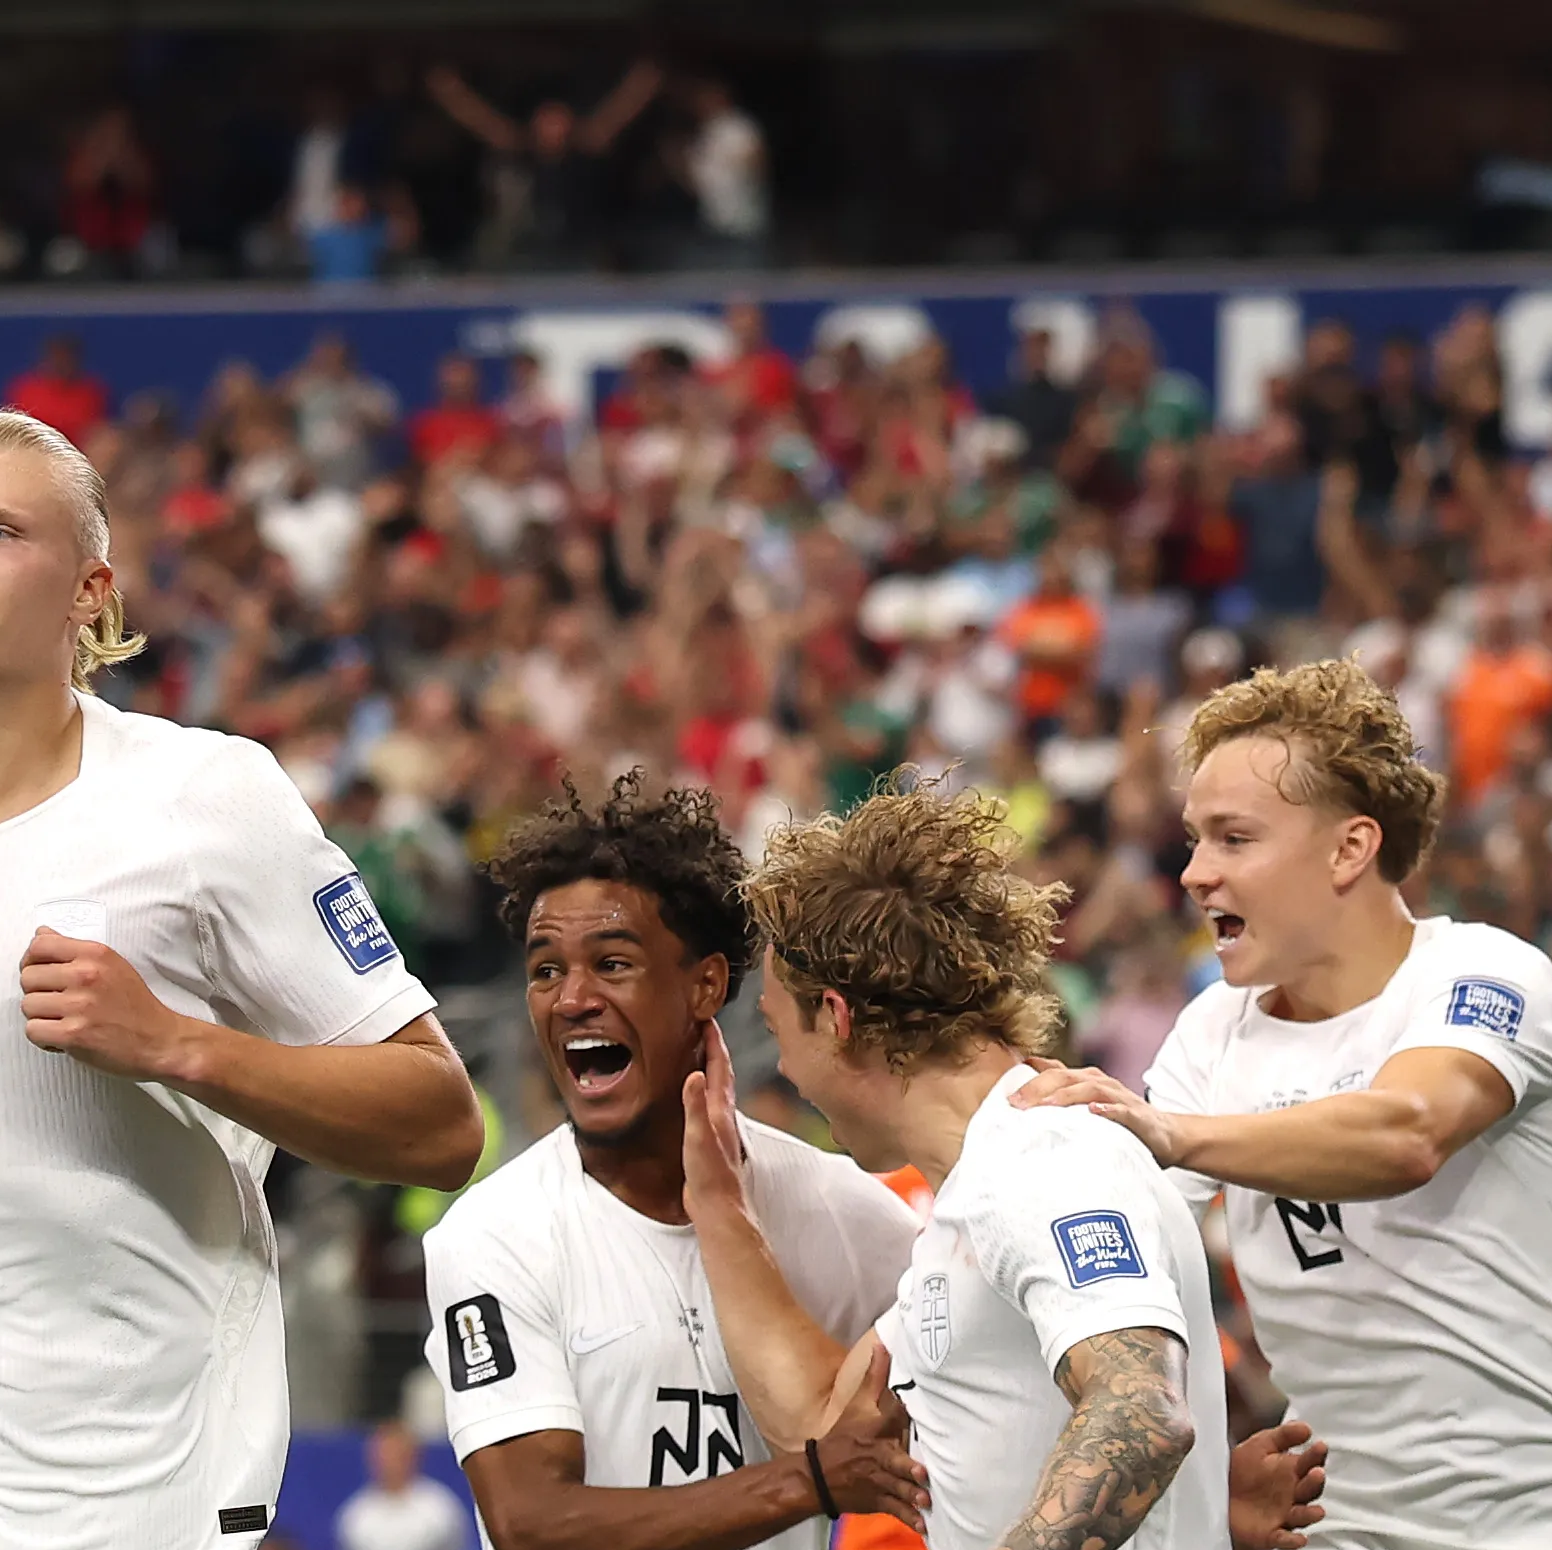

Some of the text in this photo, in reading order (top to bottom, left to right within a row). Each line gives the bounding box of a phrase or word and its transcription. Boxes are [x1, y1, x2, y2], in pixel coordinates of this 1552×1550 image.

[368, 936, 388, 950] FIFA
[1068, 1221, 1120, 1241] FOOTBALL
[1072, 1232, 1125, 1256] UNITES
[1075, 1246, 1132, 1270] the World
[1094, 1260, 1119, 1271] FIFA
